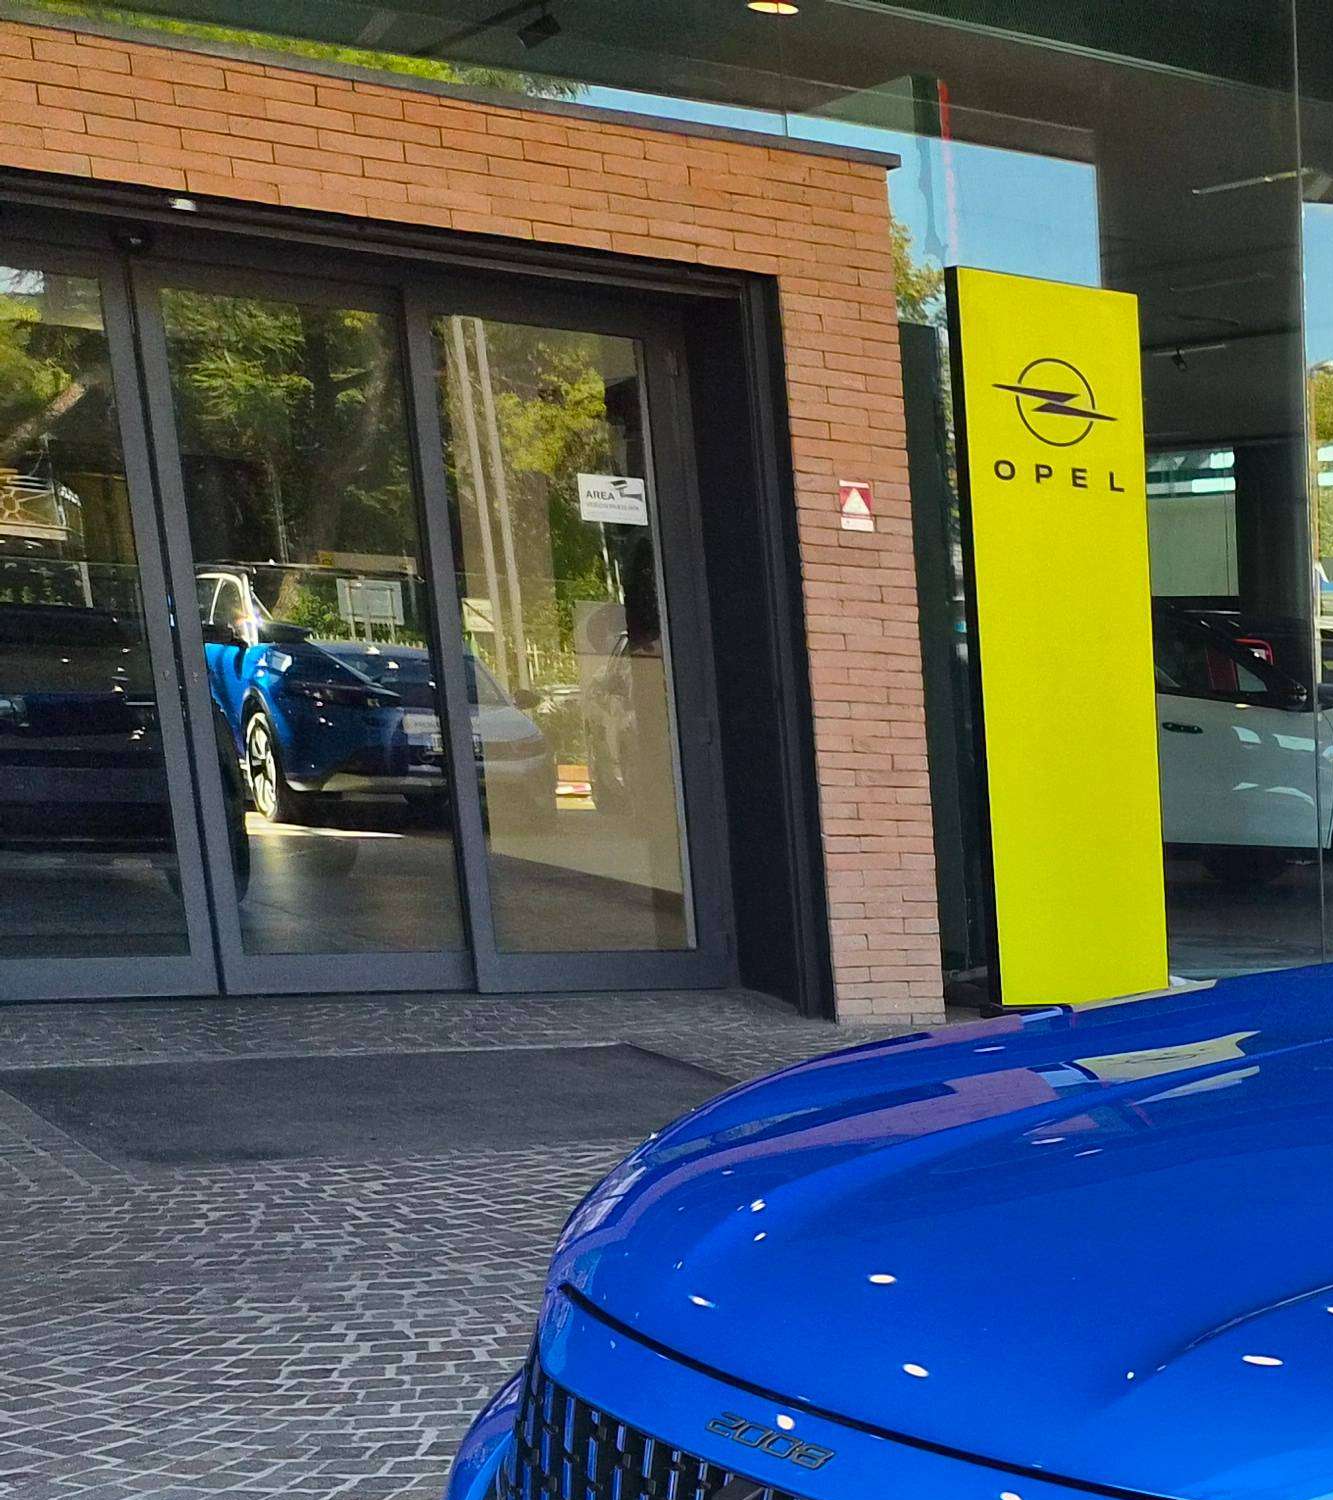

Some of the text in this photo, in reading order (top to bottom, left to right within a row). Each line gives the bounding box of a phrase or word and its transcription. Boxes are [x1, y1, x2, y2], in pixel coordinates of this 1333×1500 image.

[993, 459, 1125, 493] OPEL
[586, 490, 615, 501] AREA
[706, 1411, 835, 1470] 2008
